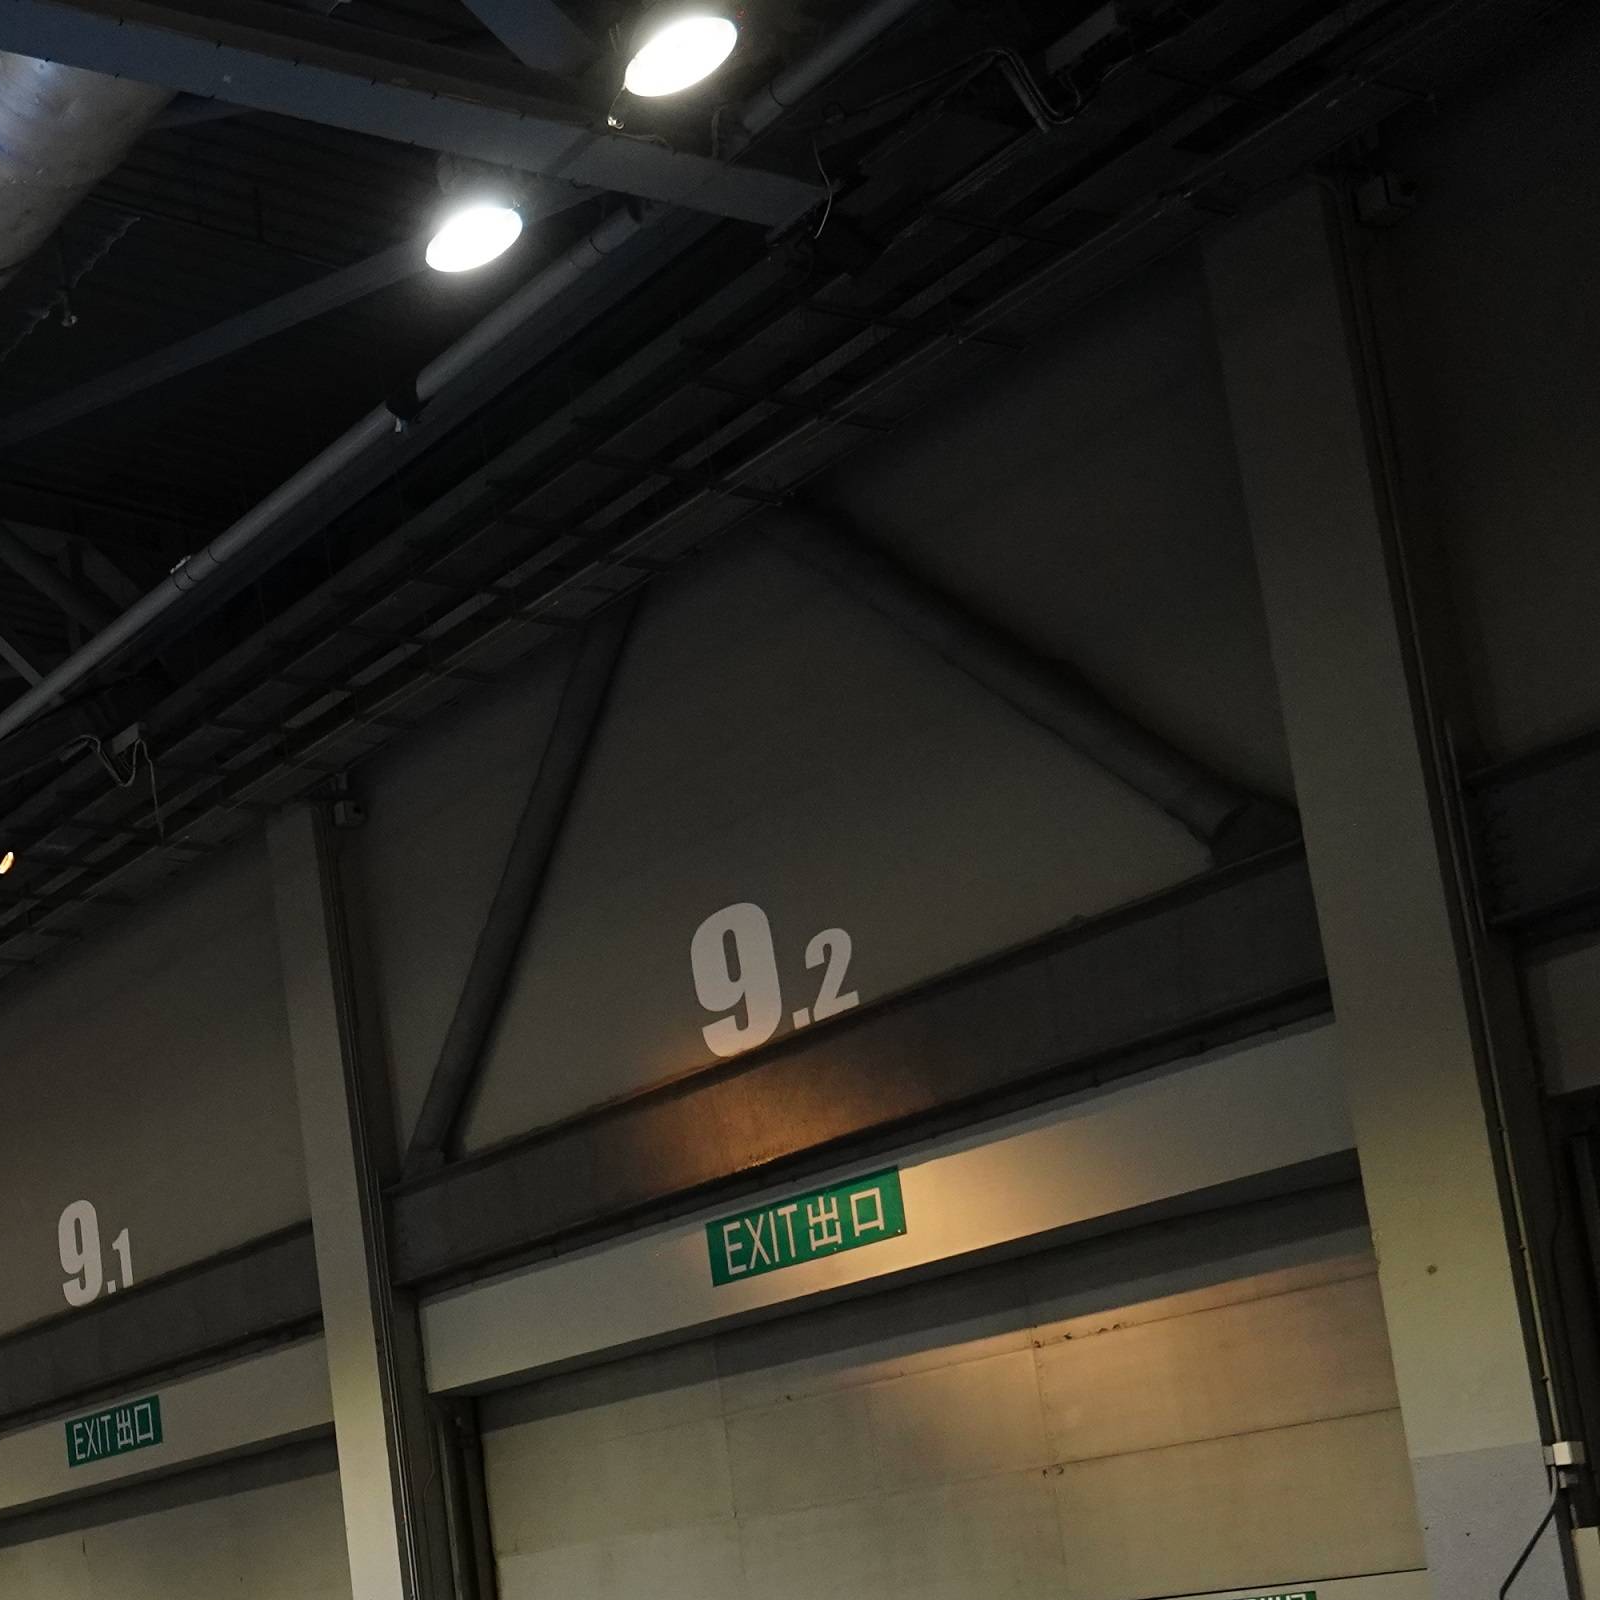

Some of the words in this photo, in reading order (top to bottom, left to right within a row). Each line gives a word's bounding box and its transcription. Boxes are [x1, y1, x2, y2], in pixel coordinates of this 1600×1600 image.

[689, 902, 859, 1058] 9.2
[57, 1200, 134, 1306] 9.1
[724, 1208, 796, 1275] EXIT
[809, 1187, 885, 1252] 出口
[73, 1412, 113, 1459] EXIT
[117, 1402, 155, 1447] 出口
